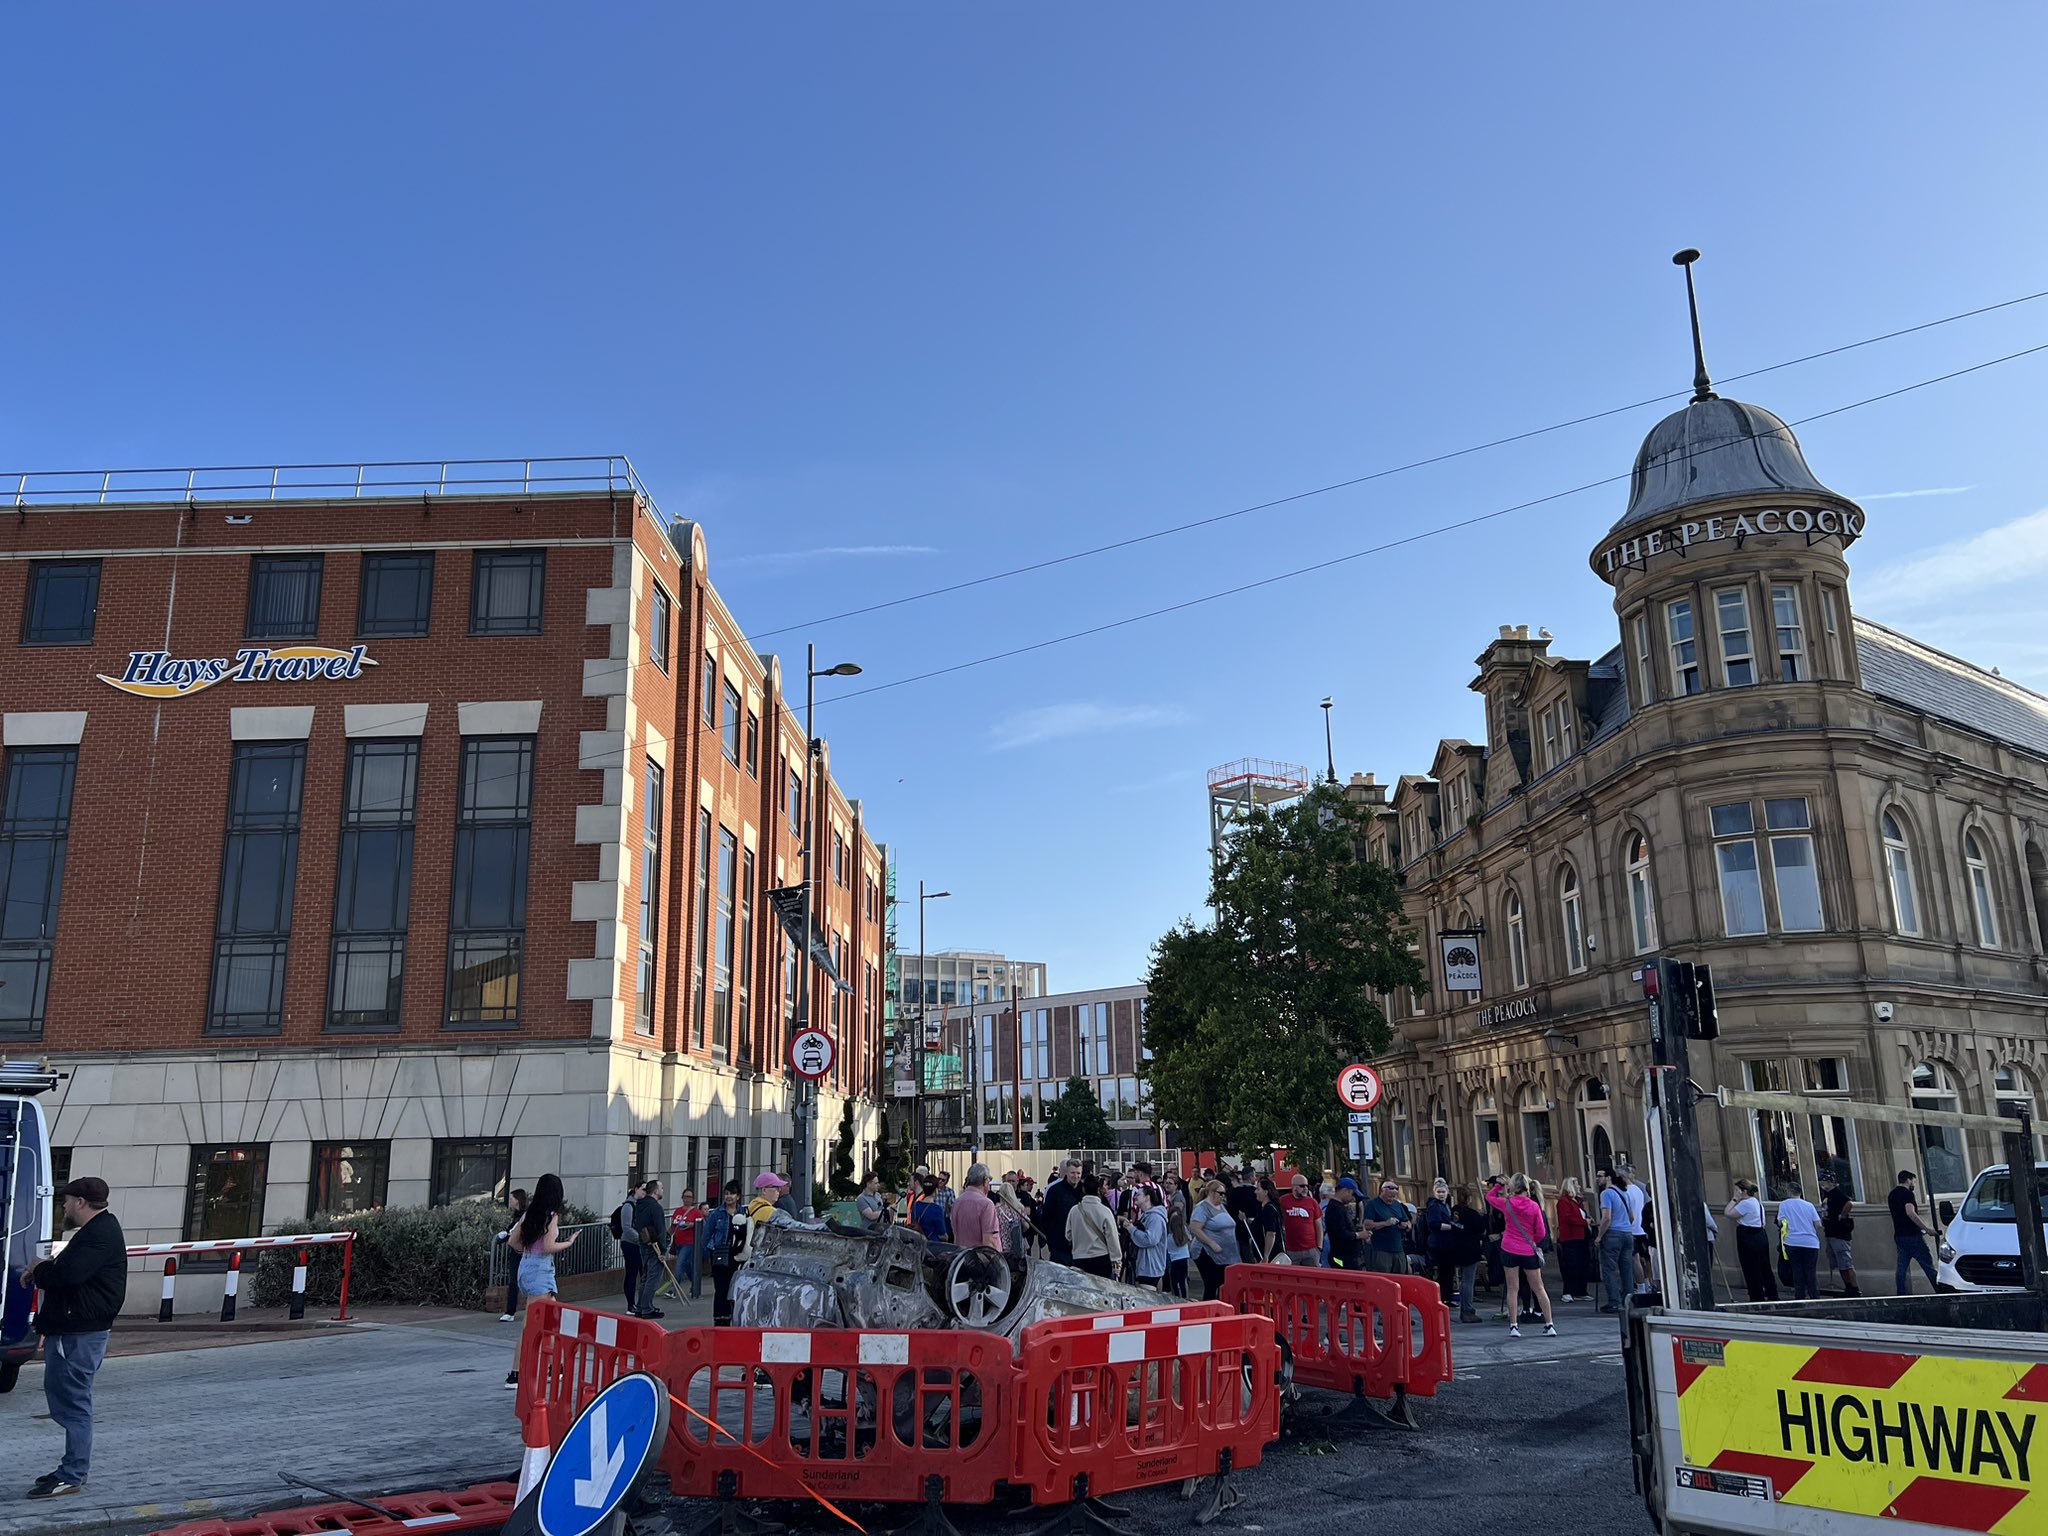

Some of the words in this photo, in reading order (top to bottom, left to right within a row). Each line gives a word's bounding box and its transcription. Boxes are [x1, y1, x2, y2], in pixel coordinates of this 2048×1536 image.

[1601, 529, 1666, 574] THE
[1680, 508, 1862, 547] PEACOCK
[121, 650, 229, 690] Hays
[232, 644, 369, 682] Travel
[1448, 972, 1477, 980] PEACOCK
[1476, 1010, 1493, 1026] THE
[1494, 996, 1537, 1022] PEACOCK
[903, 1032, 912, 1071] Potential
[1777, 1388, 2037, 1483] HIGHWAY
[802, 1469, 860, 1480] Sunderland
[1136, 1470, 1147, 1480] City
[1148, 1467, 1168, 1478] Council
[1137, 1456, 1177, 1470] Sunderland
